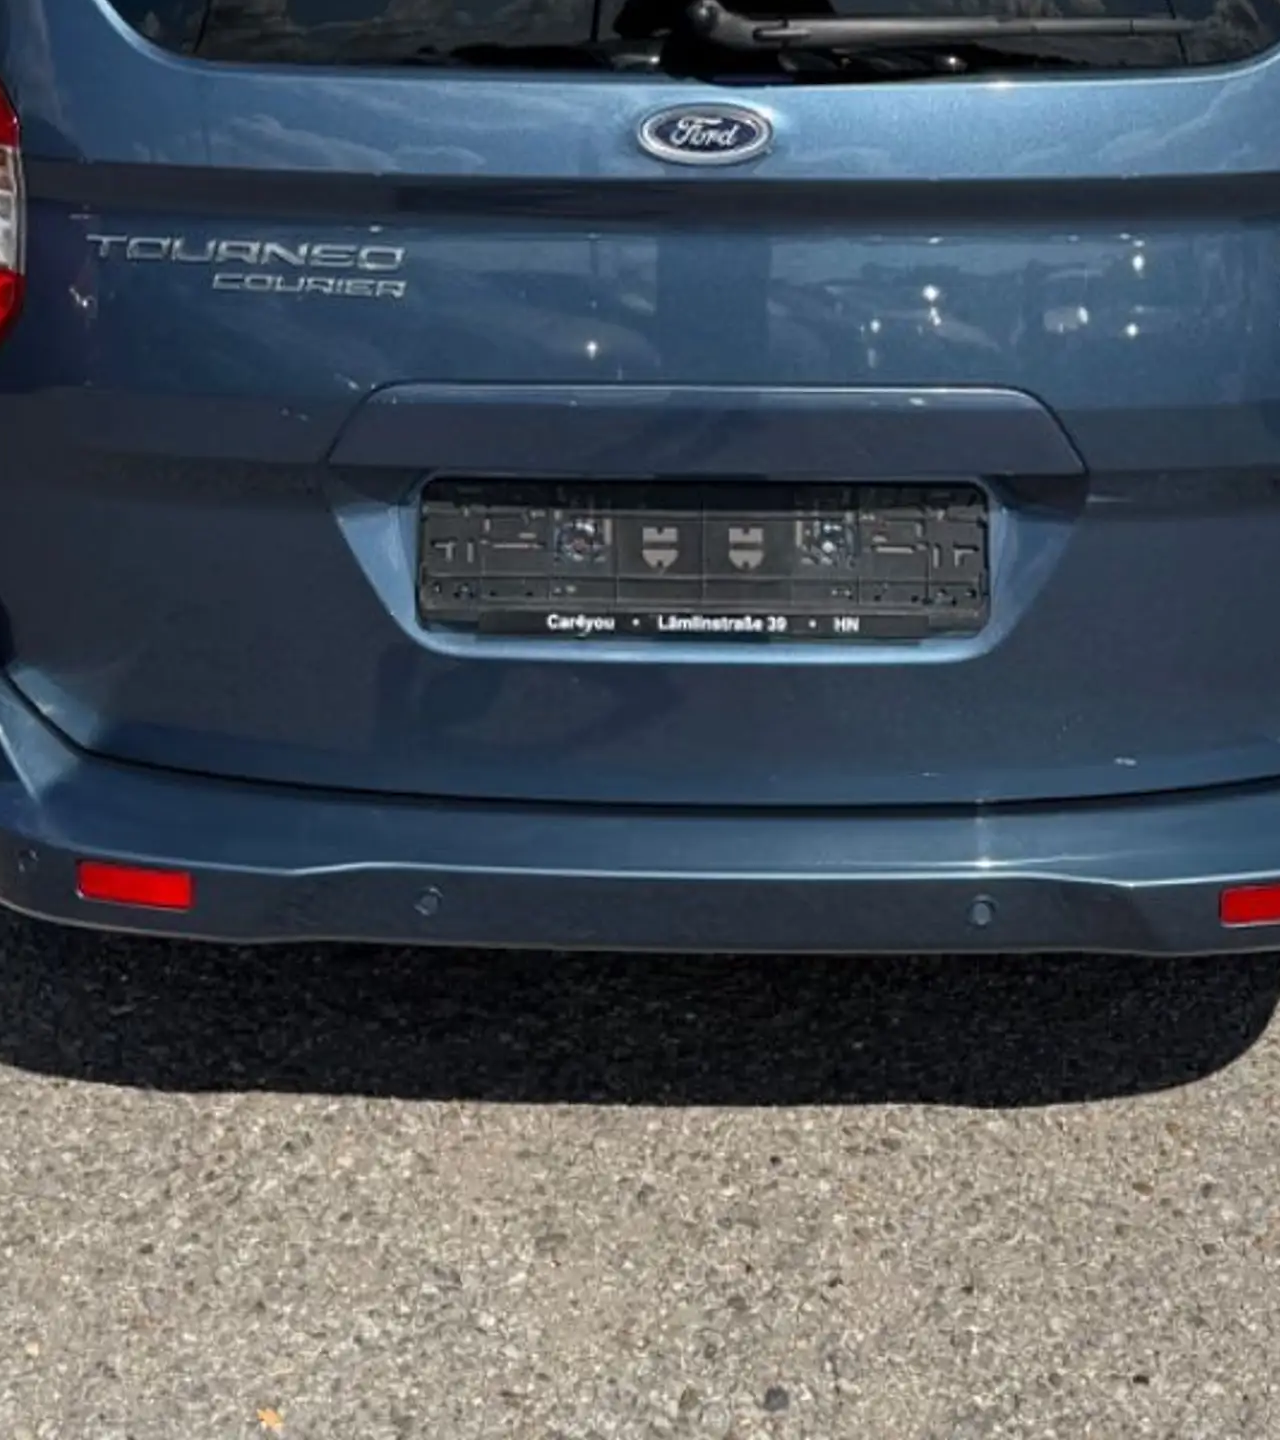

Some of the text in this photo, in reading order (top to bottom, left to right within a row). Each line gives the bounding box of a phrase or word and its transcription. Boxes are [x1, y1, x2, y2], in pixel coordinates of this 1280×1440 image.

[671, 115, 740, 147] Ford
[86, 233, 406, 270] TOURNEO
[212, 272, 408, 298] COURIER
[546, 613, 616, 637] Car4you
[833, 616, 860, 633] HN
